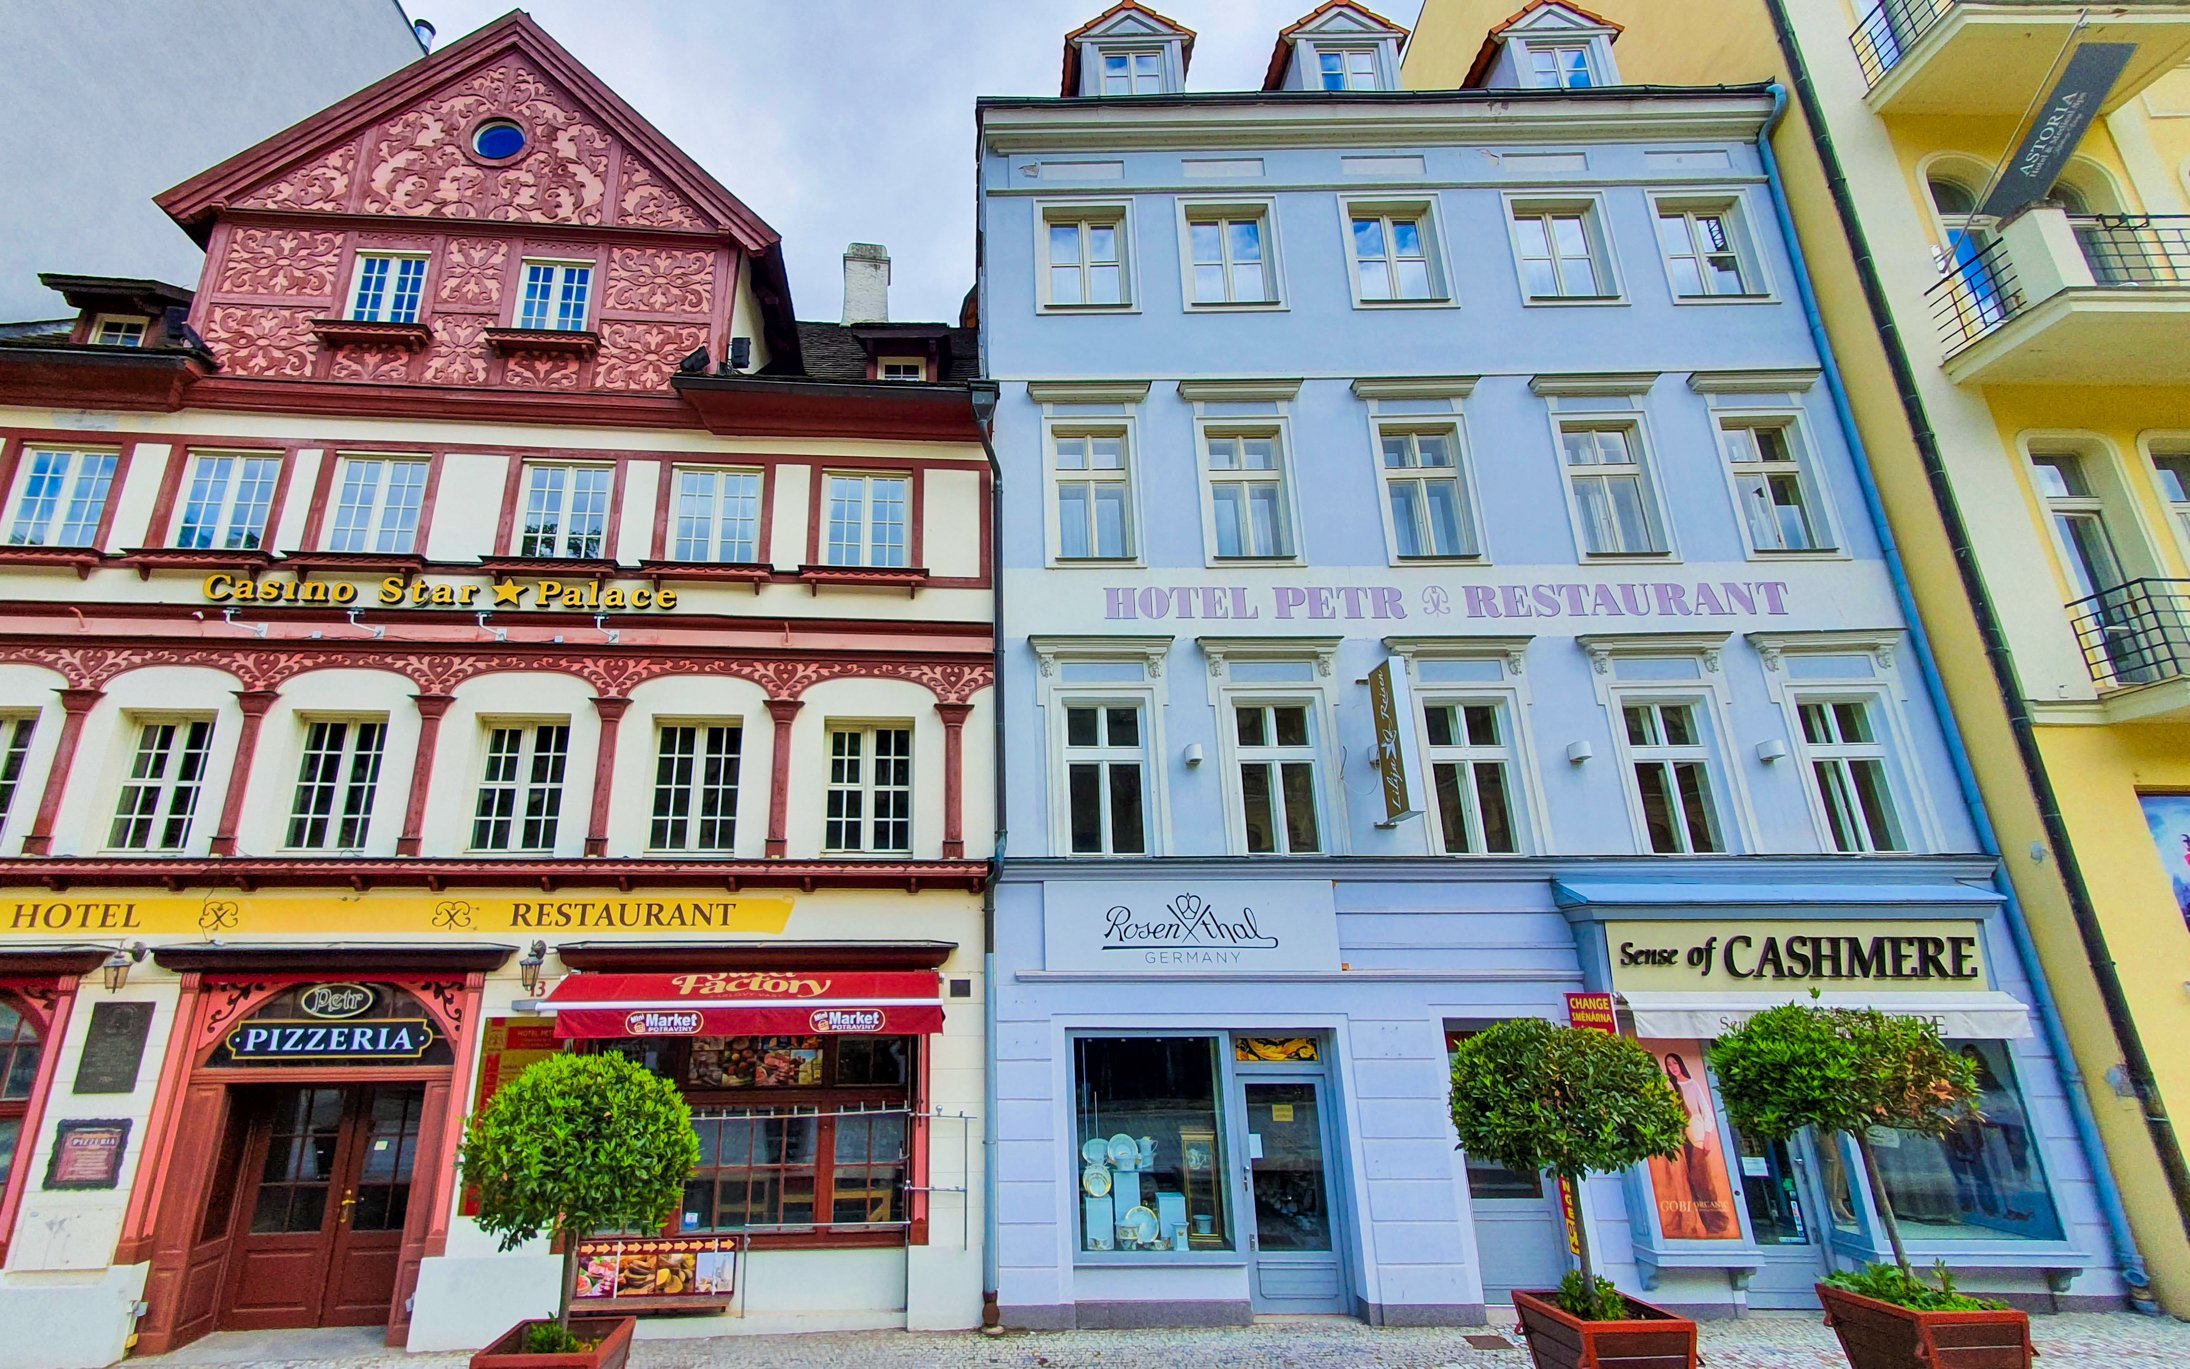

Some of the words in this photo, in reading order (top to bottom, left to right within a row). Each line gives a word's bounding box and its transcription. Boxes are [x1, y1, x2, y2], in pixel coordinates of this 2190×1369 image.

[2020, 91, 2079, 176] ASTORIA
[203, 574, 357, 602] Casino
[379, 577, 479, 604] Star
[535, 580, 678, 609] Palace
[1103, 587, 1258, 620] HOTEL
[1272, 587, 1408, 620] PETR
[1462, 581, 1789, 618] RESTAURANT
[1380, 669, 1389, 720] Reisen
[10, 903, 141, 929] HOTEL
[510, 903, 736, 928] RESTAURANT
[1144, 951, 1241, 964] GERMANY
[1620, 942, 1679, 967] Sense
[1687, 937, 1717, 977] of
[1723, 935, 1979, 980] CASHMERE
[672, 974, 831, 998] Factory
[312, 988, 363, 1013] Petr
[1569, 997, 1610, 1010] CHANGE
[646, 1013, 697, 1027] Market
[829, 1011, 880, 1025] Market
[243, 1027, 414, 1051] PIZZERIA
[72, 1137, 117, 1146] PIZZERIA
[1660, 1200, 1691, 1212] GOBI
